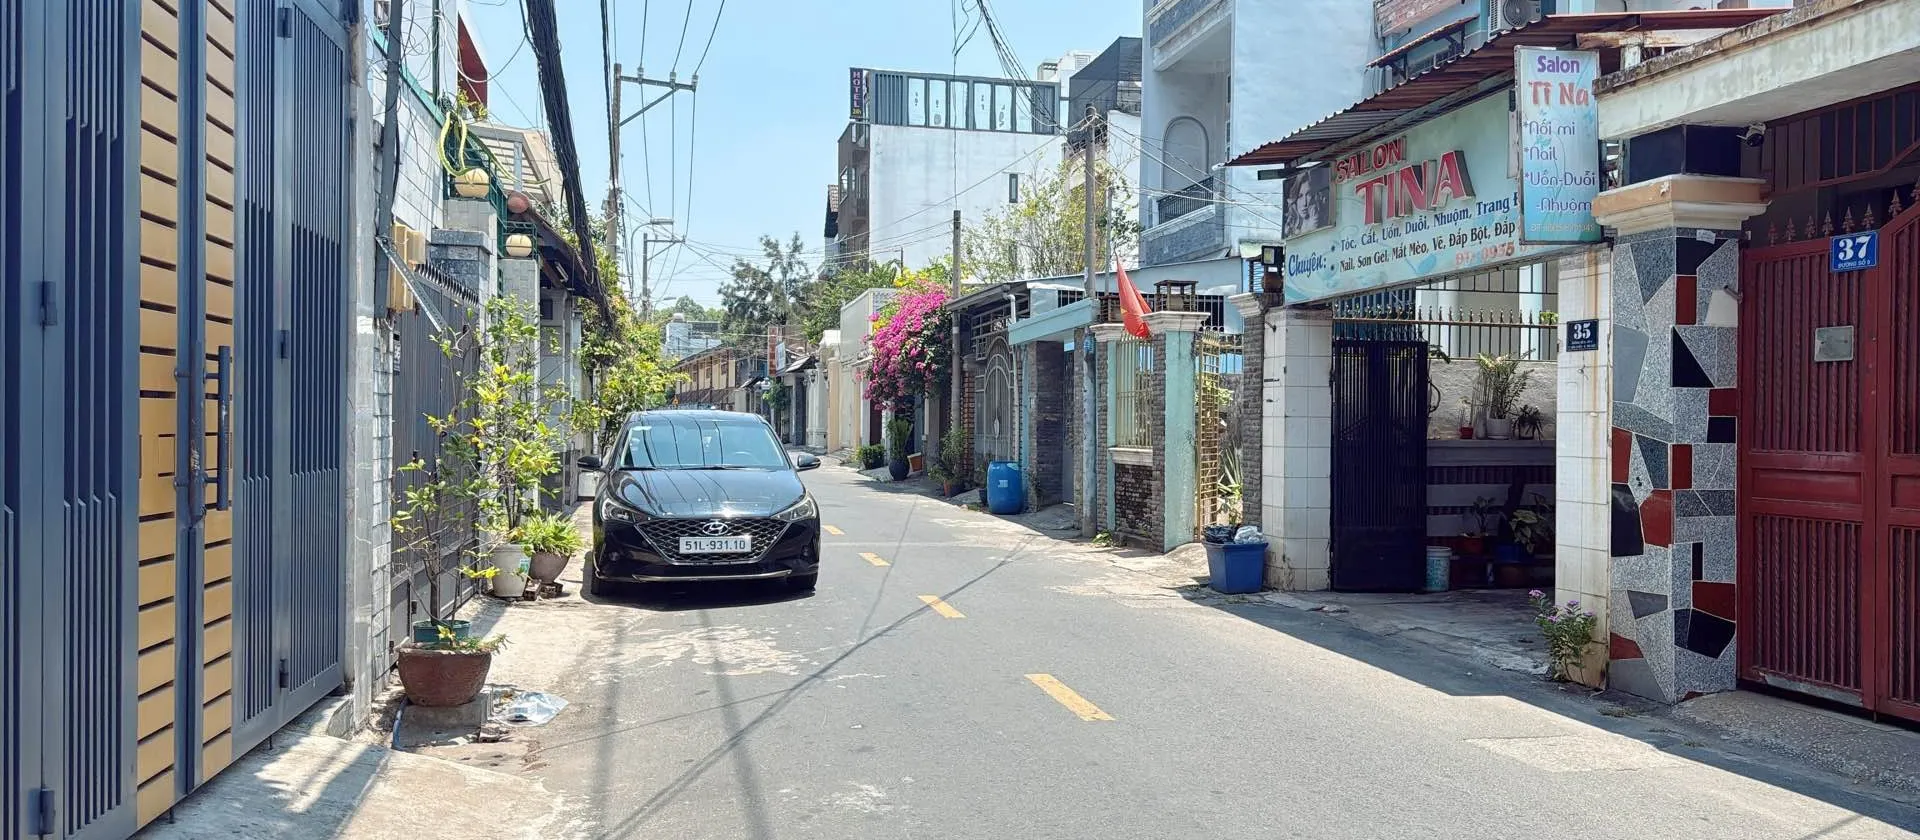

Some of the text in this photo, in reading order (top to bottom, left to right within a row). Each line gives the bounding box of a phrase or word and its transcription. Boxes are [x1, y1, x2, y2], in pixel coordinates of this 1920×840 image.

[1537, 55, 1580, 73] Salon
[853, 71, 861, 108] HOTEL
[1558, 82, 1589, 106] Na
[1557, 122, 1575, 135] mi
[1335, 137, 1405, 184] SALON
[1355, 151, 1475, 226] TINA
[1434, 207, 1473, 227] Nhuộm,
[1476, 197, 1510, 216] Trang
[1340, 257, 1356, 272] Nail,
[1374, 249, 1389, 265] Gel,
[1408, 241, 1430, 257] Mèo,
[1449, 227, 1468, 248] Đắp
[1470, 225, 1491, 244] Bột,
[1494, 215, 1516, 238] Đắp
[1838, 235, 1872, 261] 37
[1288, 252, 1327, 278] Chuyên:
[1573, 322, 1591, 340] 35
[685, 540, 746, 551] 51L-931.10
